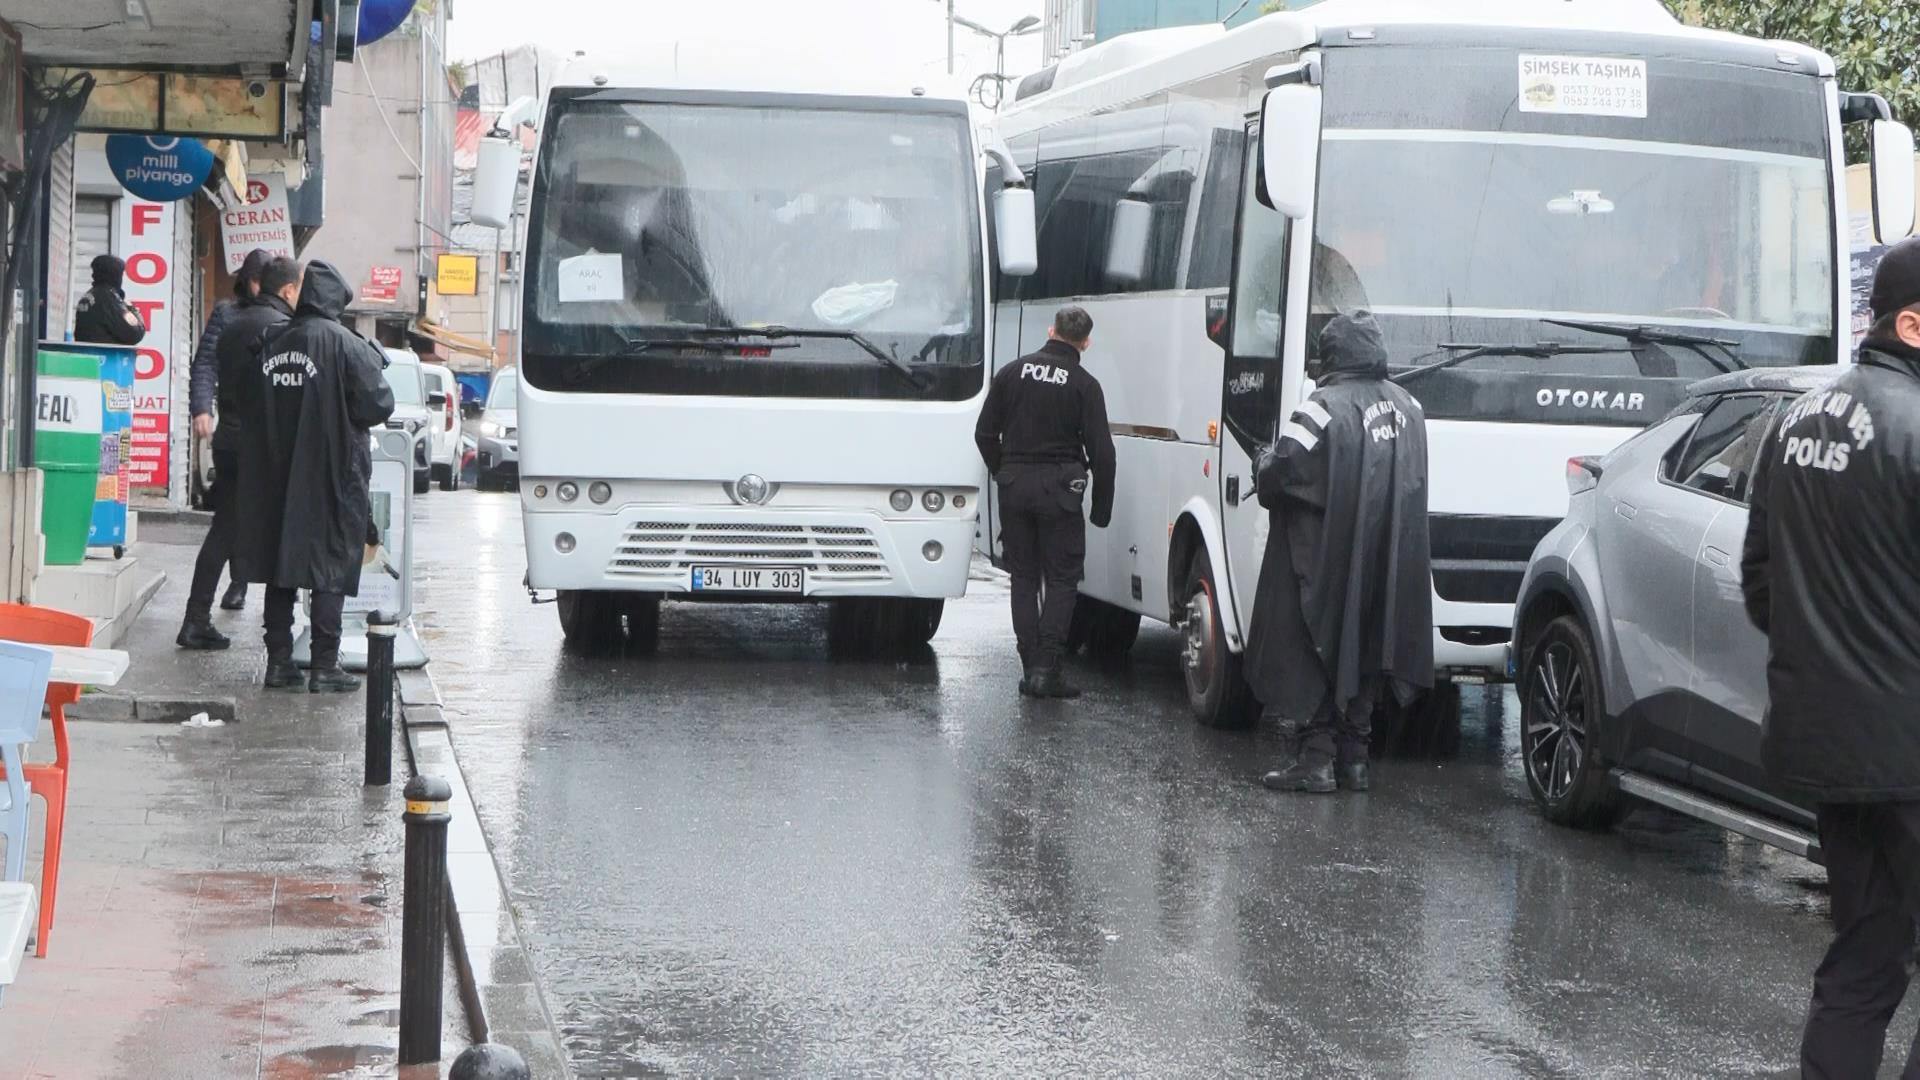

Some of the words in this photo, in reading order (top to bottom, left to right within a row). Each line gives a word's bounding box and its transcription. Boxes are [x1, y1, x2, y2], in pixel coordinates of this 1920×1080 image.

[1523, 58, 1580, 76] ŞİMŞEK
[1585, 63, 1641, 79] TAŞIMA
[143, 154, 178, 169] milli
[126, 167, 193, 186] piyango
[225, 208, 284, 226] CERAN
[37, 393, 71, 423] EAL
[1536, 388, 1645, 411] OTOKAR
[704, 570, 722, 587] 34
[733, 571, 761, 588] LUY
[772, 571, 800, 588] 303
